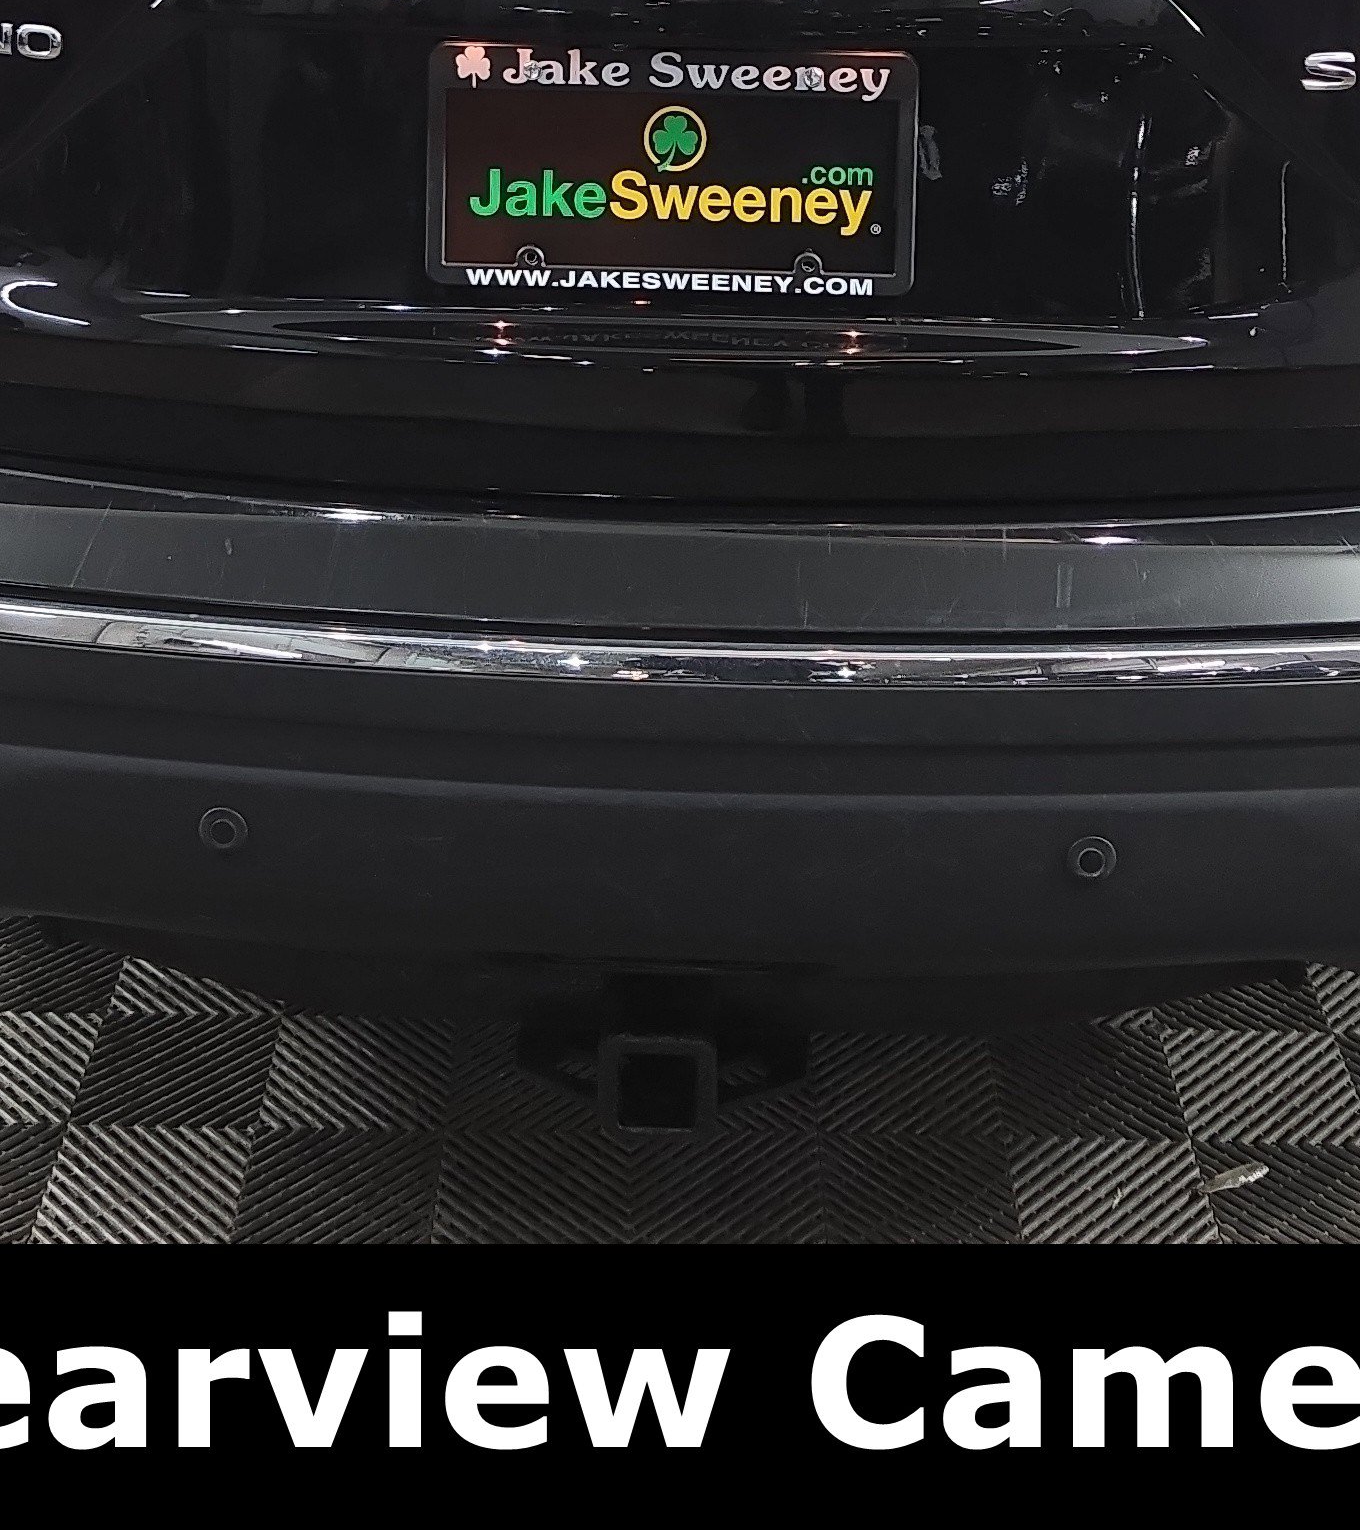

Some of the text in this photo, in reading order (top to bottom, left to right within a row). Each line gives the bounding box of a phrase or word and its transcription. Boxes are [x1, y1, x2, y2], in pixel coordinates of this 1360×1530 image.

[503, 48, 891, 101] Jake Sweeney
[801, 166, 874, 186] .com
[466, 269, 874, 297] WWW.JAKESWEENEY.COM
